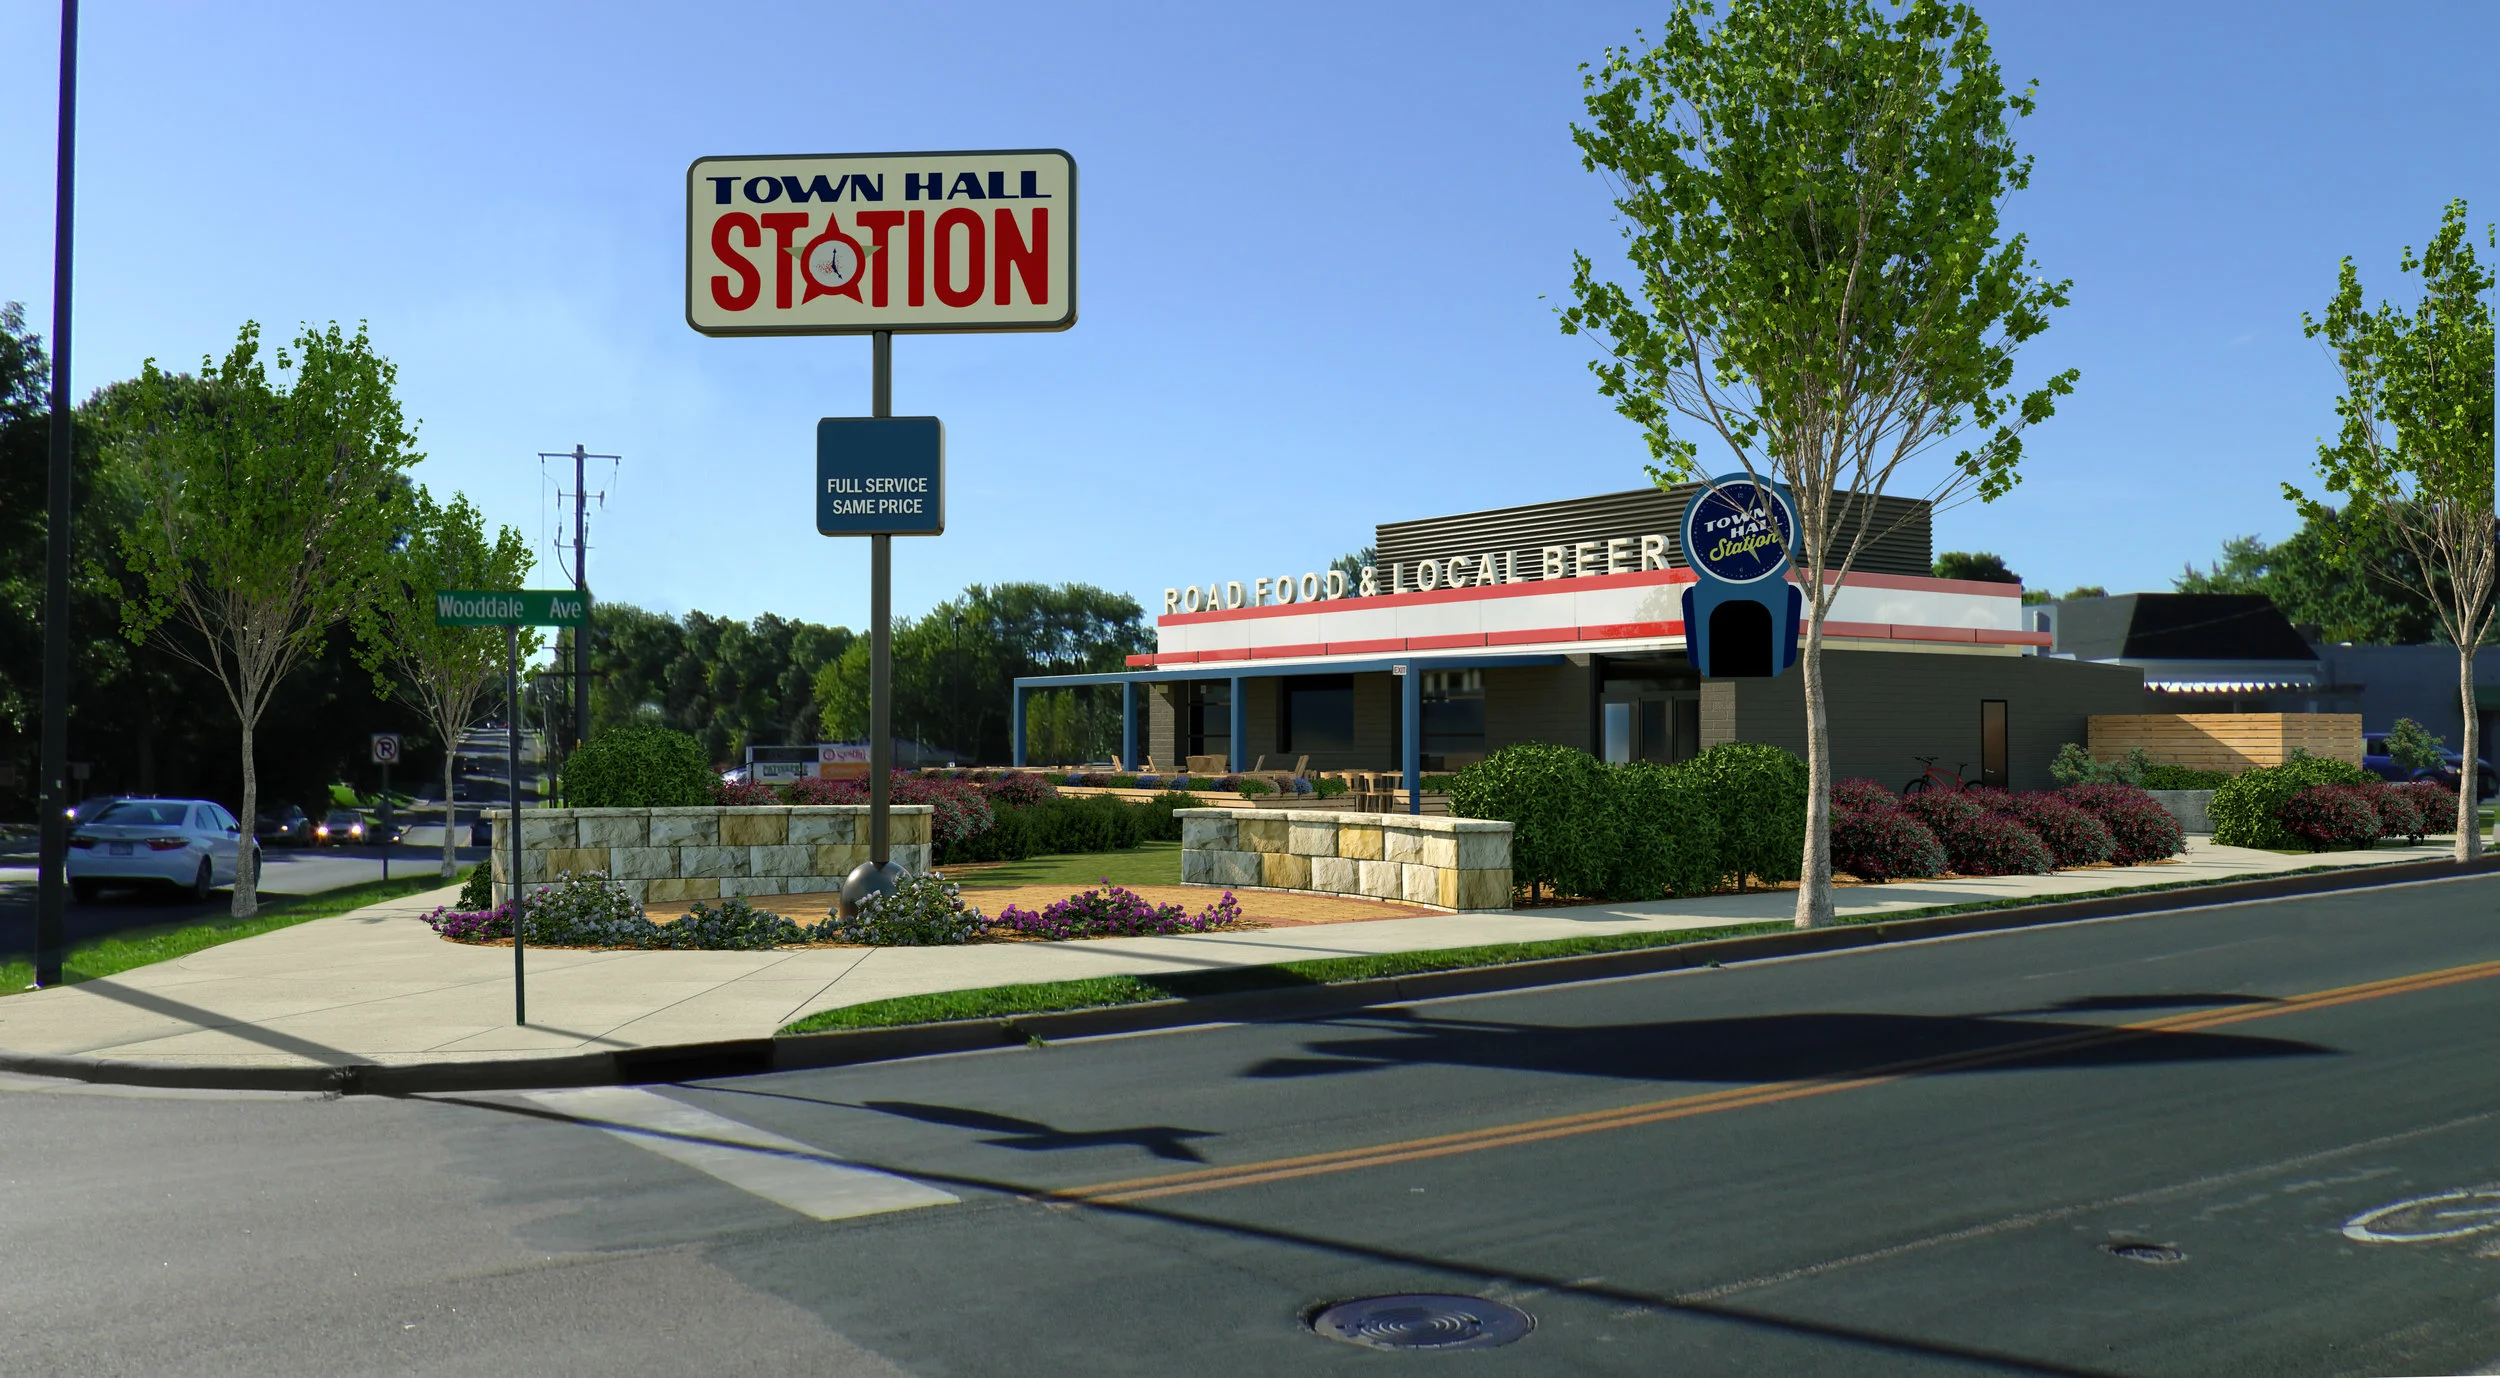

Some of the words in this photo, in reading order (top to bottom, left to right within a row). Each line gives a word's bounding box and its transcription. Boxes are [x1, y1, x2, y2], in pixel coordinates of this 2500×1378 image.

[706, 172, 884, 205] TOWN
[905, 170, 1052, 201] HALL
[827, 478, 863, 494] FULL
[865, 477, 928, 493] SERVICE
[832, 499, 876, 515] SAME
[879, 498, 923, 514] PRICE
[1703, 507, 1766, 533] TOWN
[1709, 534, 1780, 562] Station
[1164, 580, 1248, 616] ROAD
[1255, 569, 1349, 608] FOOD
[1359, 565, 1383, 598] &
[1392, 550, 1528, 596] LOCAL
[1542, 534, 1670, 582] BEER
[438, 595, 524, 619] Wooddale
[549, 596, 582, 619] Ave
[1394, 666, 1406, 674] EXIT
